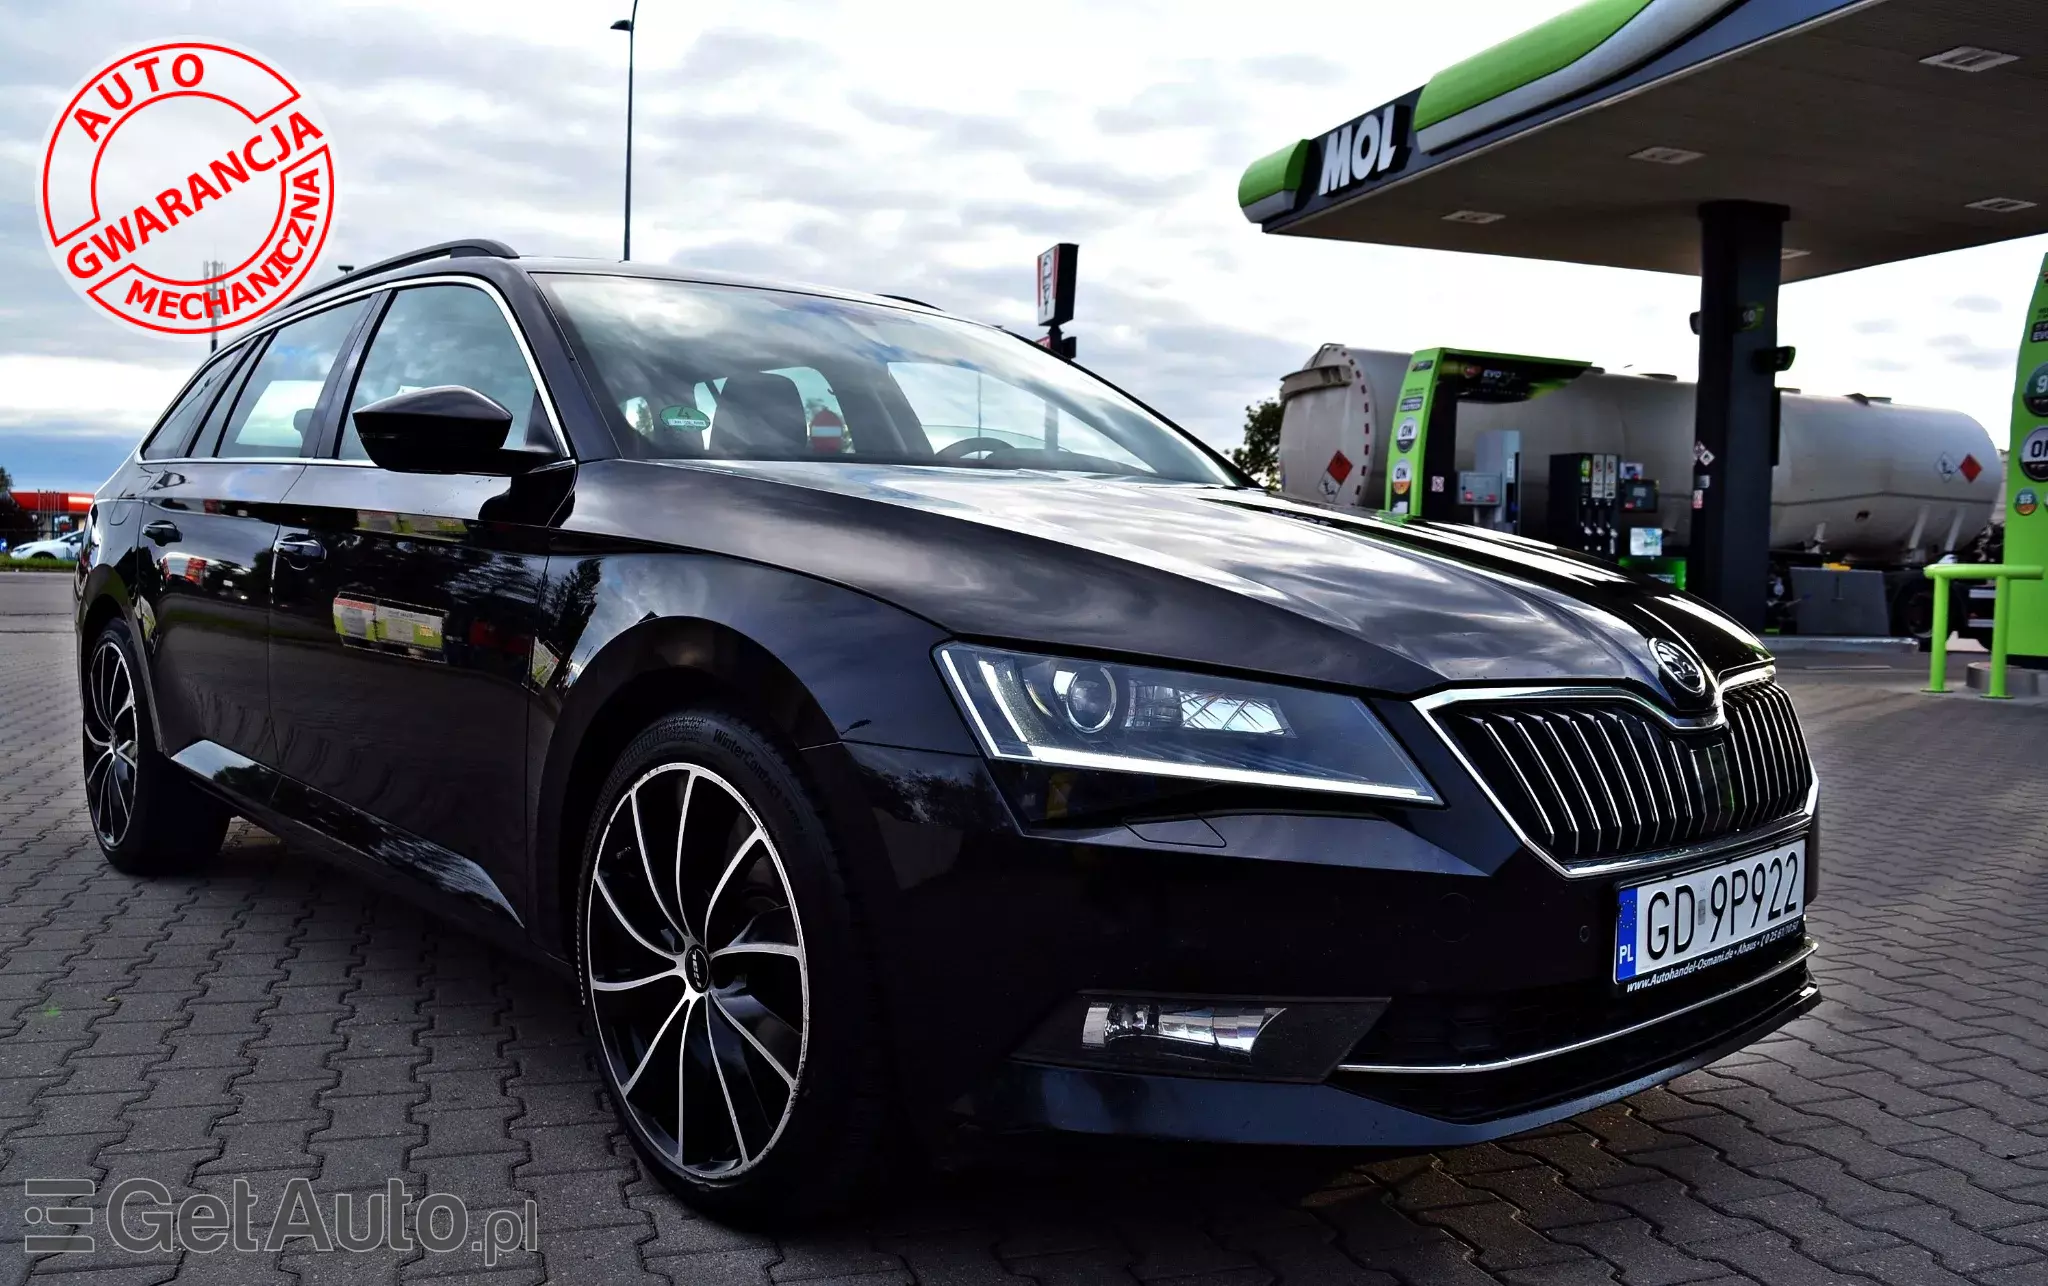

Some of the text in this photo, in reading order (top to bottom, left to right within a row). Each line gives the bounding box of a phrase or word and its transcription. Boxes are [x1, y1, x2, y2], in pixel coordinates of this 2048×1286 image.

[1318, 104, 1397, 196] MOL
[2036, 375, 2048, 394] 9
[713, 729, 782, 800] WinterContact
[1647, 851, 1798, 960] GD 9P922
[1619, 944, 1634, 965] PL
